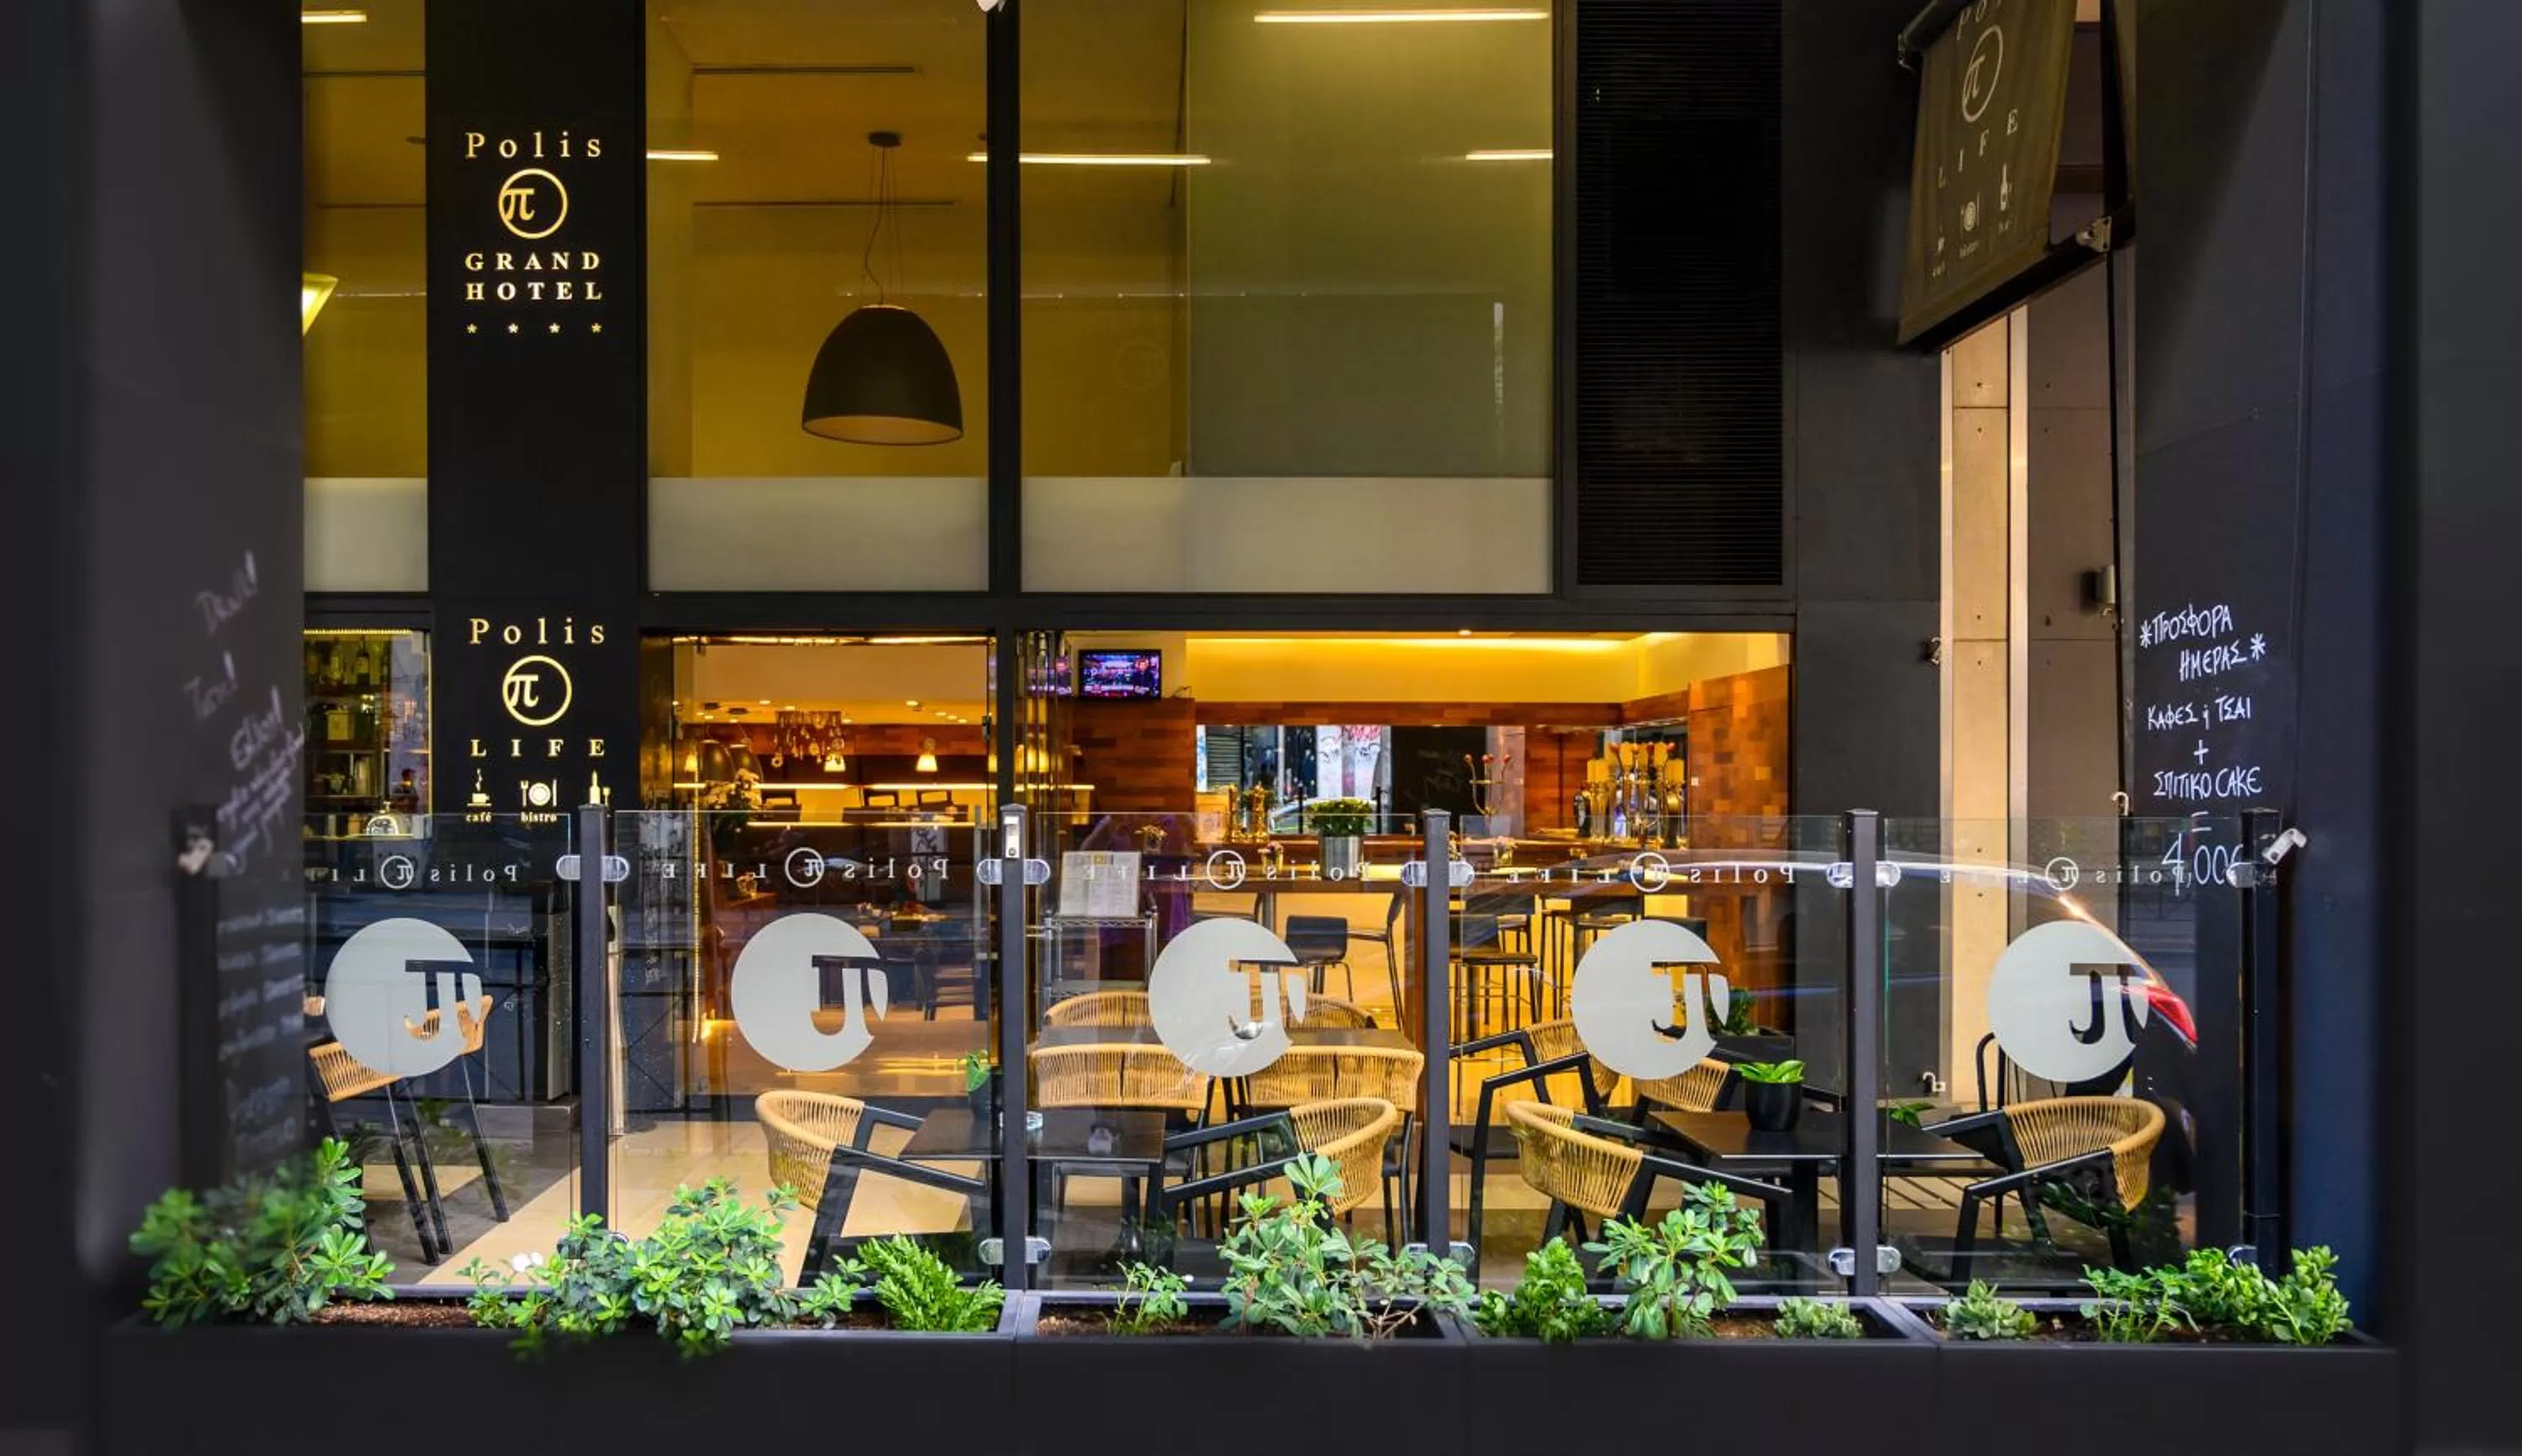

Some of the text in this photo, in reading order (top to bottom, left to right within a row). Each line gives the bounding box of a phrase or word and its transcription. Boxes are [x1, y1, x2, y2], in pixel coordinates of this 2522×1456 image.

[465, 130, 601, 158] Polis
[1938, 108, 2018, 189] LIFE
[465, 252, 599, 271] GRAND
[465, 282, 602, 300] HOTEL
[469, 617, 604, 645] Polis
[2214, 695, 2250, 722] ΤΣΑΙ
[470, 739, 604, 757] LIFE
[2153, 766, 2261, 800] ΣΠΙΤΙΚΟ CAKE
[520, 811, 557, 823] bistro
